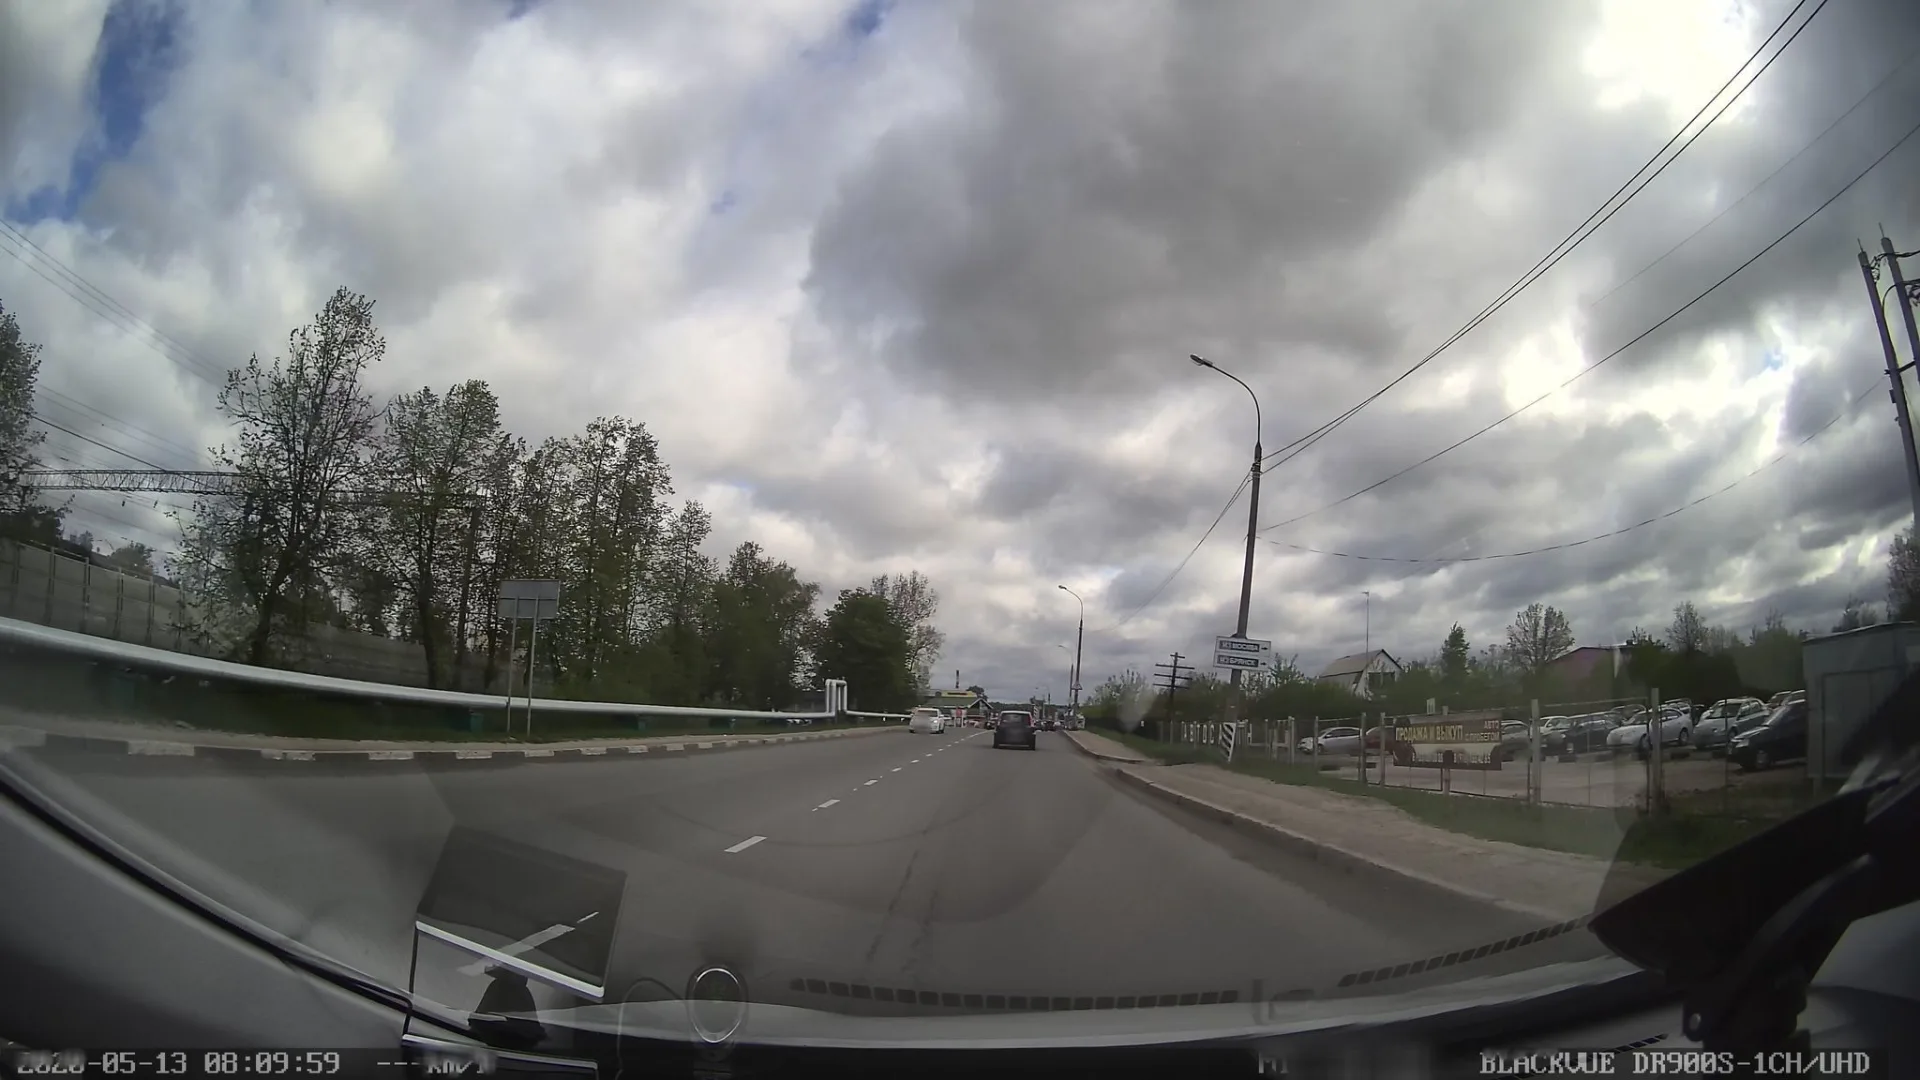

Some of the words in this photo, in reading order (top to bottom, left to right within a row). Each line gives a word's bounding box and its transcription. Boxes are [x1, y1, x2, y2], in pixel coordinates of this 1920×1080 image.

[1395, 727, 1428, 743] ПРОДАЖА
[1429, 726, 1435, 741] И
[1436, 725, 1463, 741] ВЫКУП
